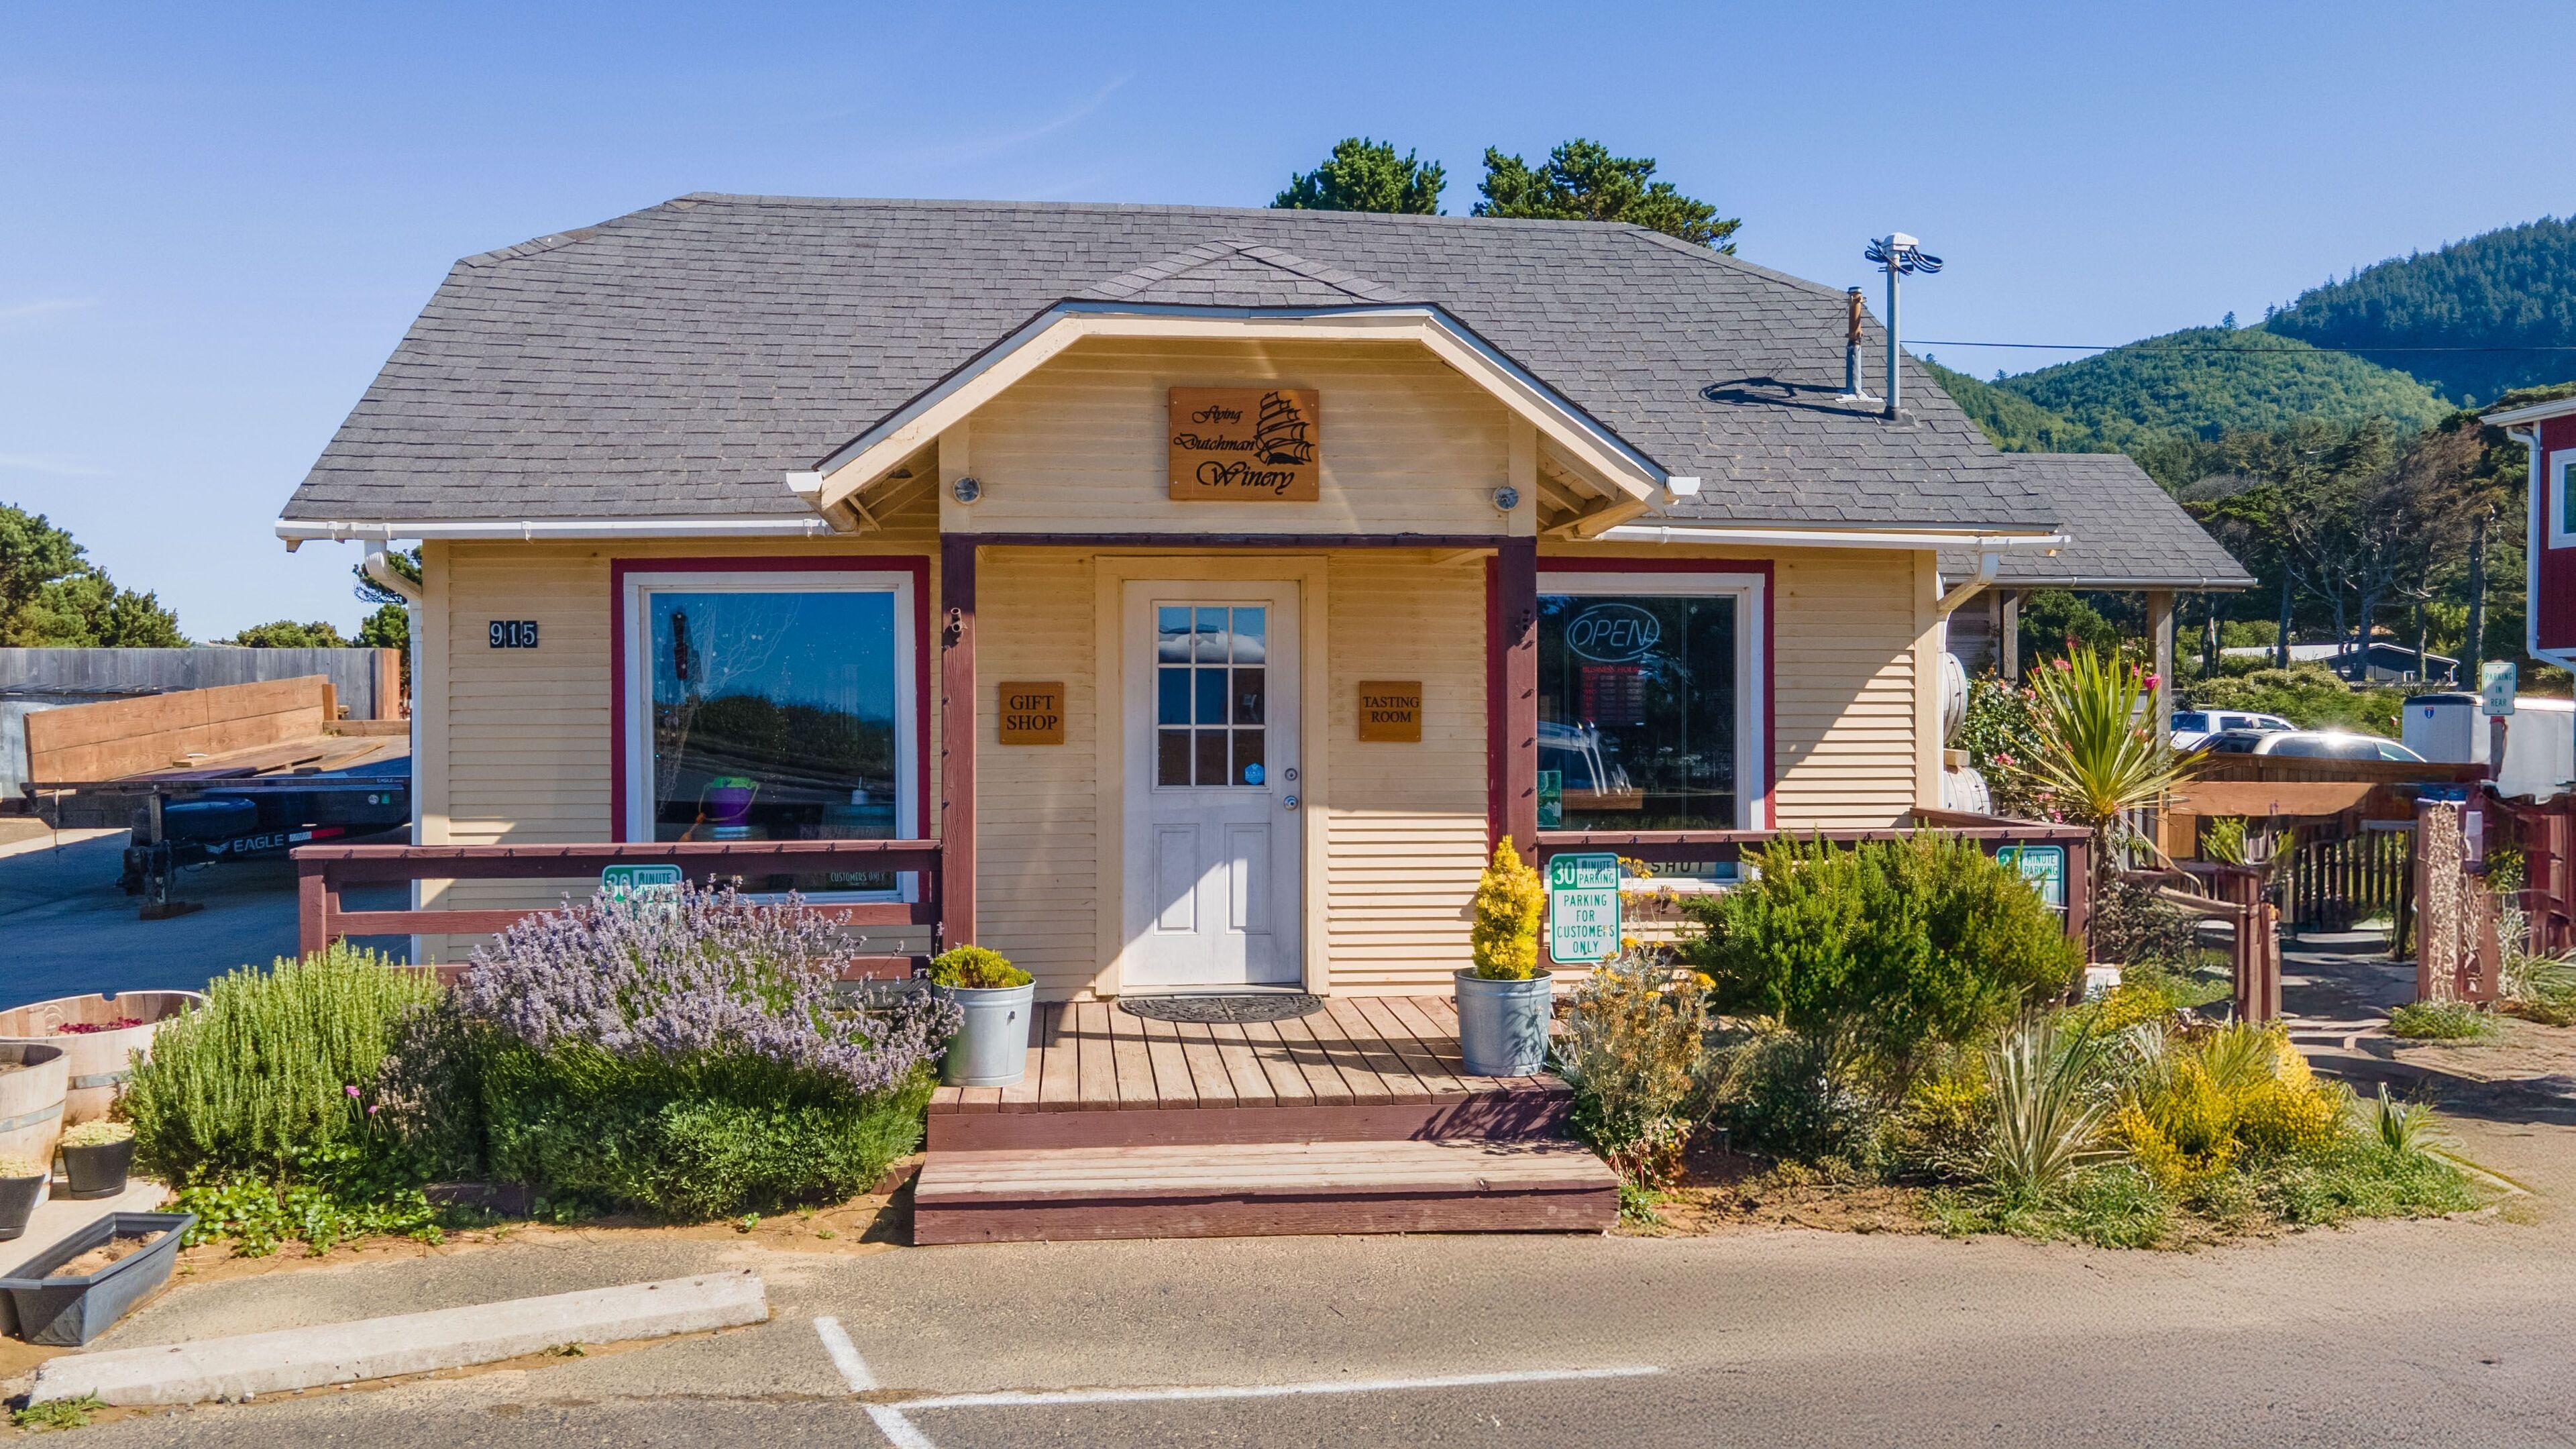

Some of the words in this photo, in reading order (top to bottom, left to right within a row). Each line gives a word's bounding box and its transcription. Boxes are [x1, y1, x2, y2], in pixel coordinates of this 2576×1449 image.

[1173, 433, 1255, 451] Dutchman
[1196, 461, 1295, 495] Winery
[490, 623, 535, 645] 915
[1572, 619, 1650, 646] OPEN
[2485, 672, 2513, 681] PARKING
[2496, 686, 2502, 694] IN
[1010, 695, 1055, 710] GIFT
[1363, 696, 1419, 708] TASTING
[2490, 698, 2507, 706] REAR
[1007, 715, 1057, 730] SHOP
[1371, 712, 1411, 722] ROOM
[233, 834, 284, 852] EAGLE
[2027, 853, 2055, 863] MINUTE
[1582, 861, 1611, 871] MINUTE
[639, 873, 672, 885] MINUTE
[830, 871, 867, 881] CUSTOMERS
[1554, 861, 1575, 885] 30
[1579, 873, 1614, 884] PARKING
[1564, 894, 1607, 906] PARKING
[1576, 910, 1595, 922] FOR
[1573, 941, 1599, 953] ONLY
